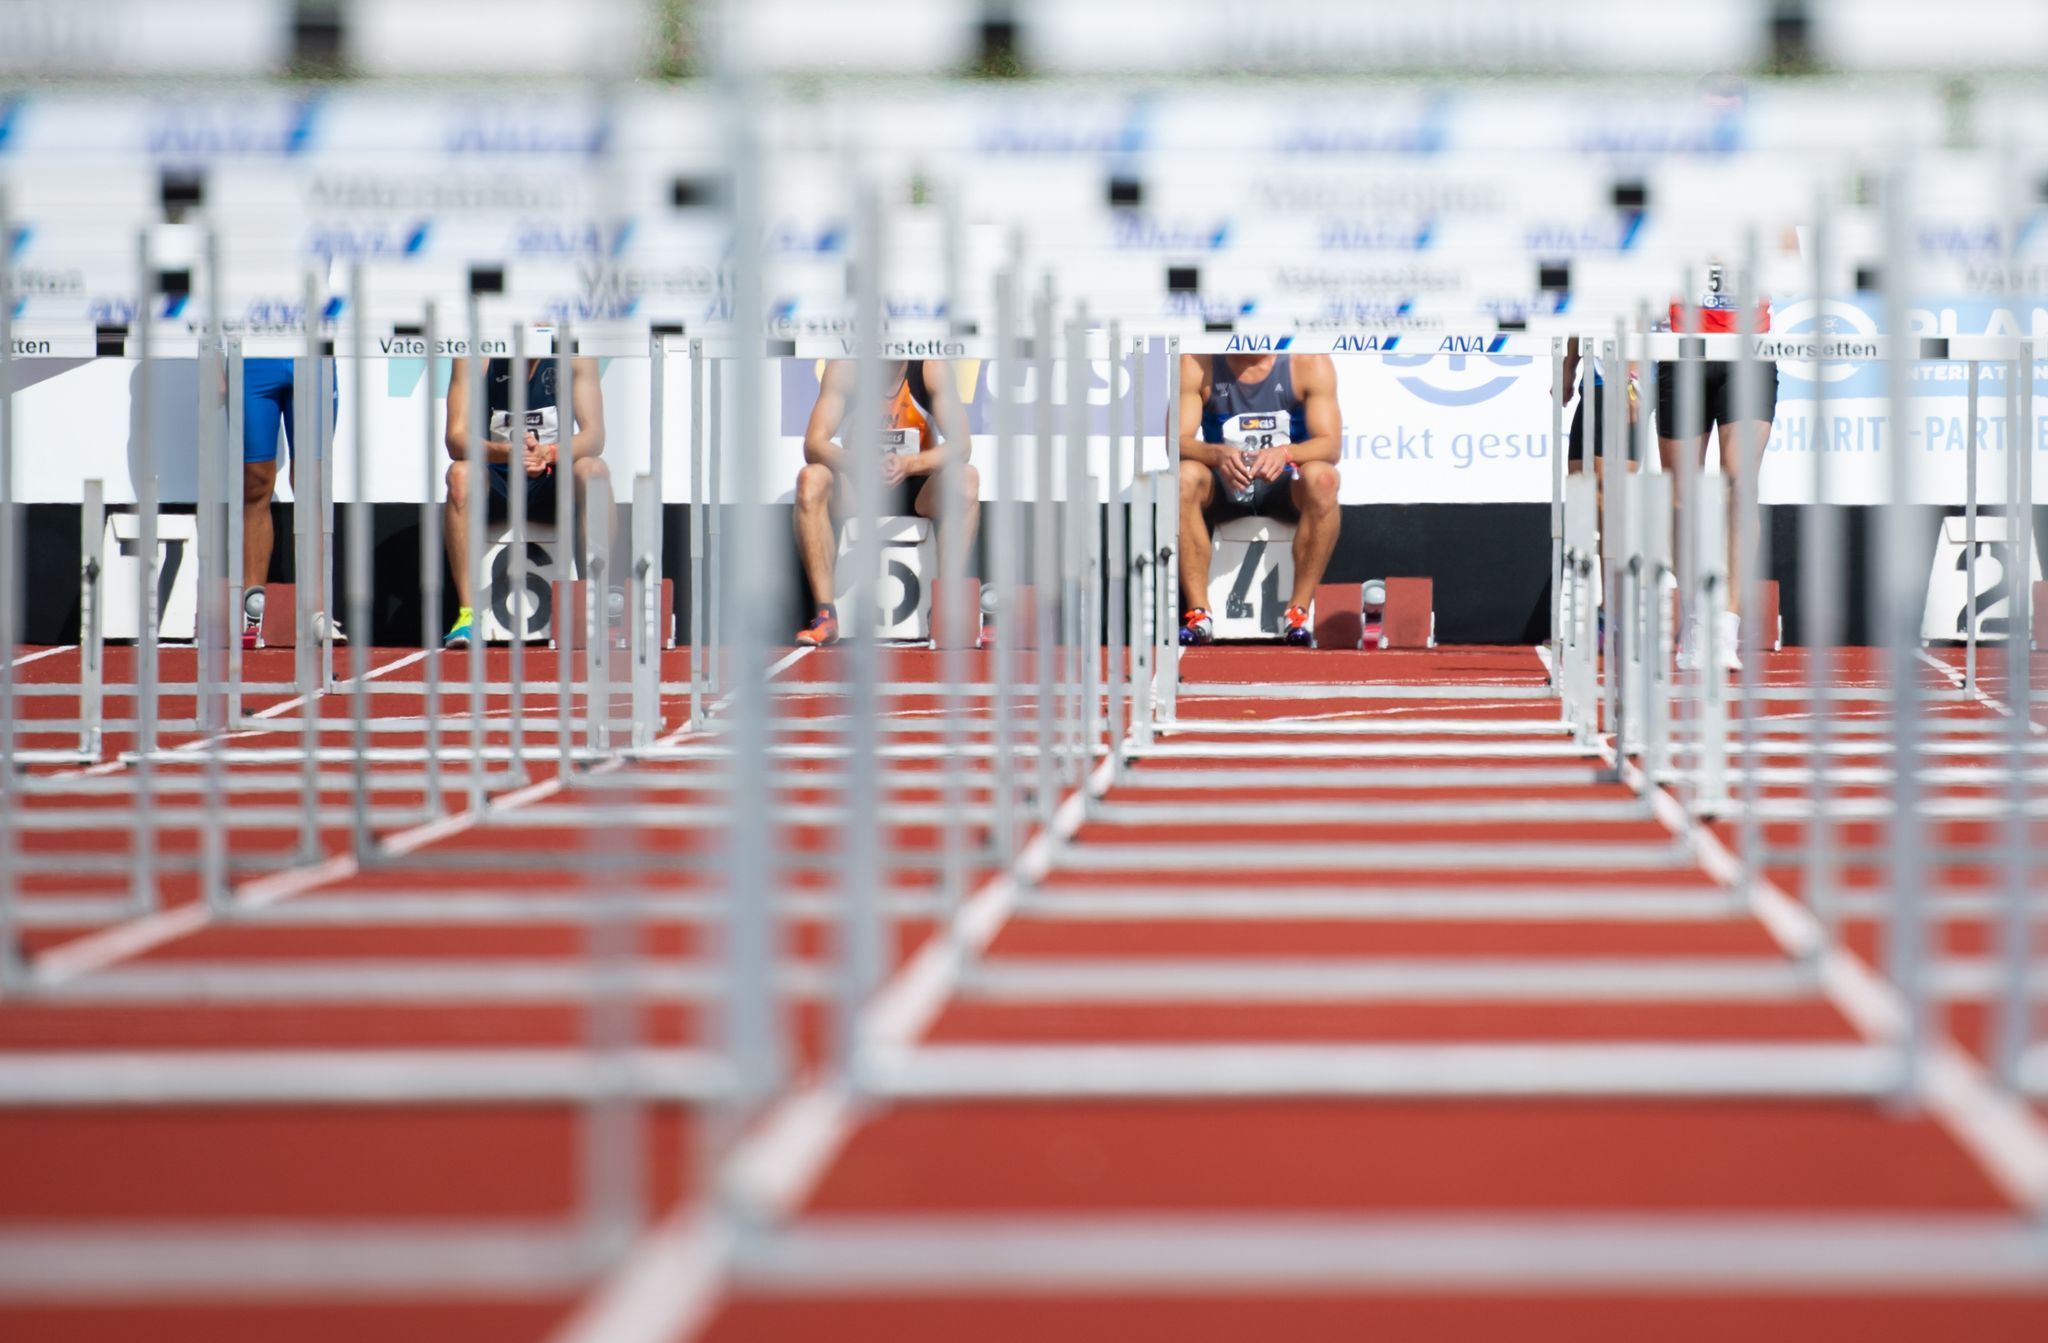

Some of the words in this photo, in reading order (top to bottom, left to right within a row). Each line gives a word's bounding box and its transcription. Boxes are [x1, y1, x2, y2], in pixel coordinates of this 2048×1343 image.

[11, 339, 51, 354] tten
[380, 337, 507, 354] Vatesteen
[841, 338, 966, 355] Vrstetten
[1226, 335, 1271, 351] ANA
[1333, 335, 1378, 351] ANA
[1439, 335, 1484, 353] ANA
[1752, 340, 1877, 357] Vatersetten
[1342, 426, 1434, 460] irekt
[120, 538, 185, 639] 7
[491, 541, 553, 634] 6
[1226, 540, 1291, 634] 4
[1956, 541, 2022, 634] 2
